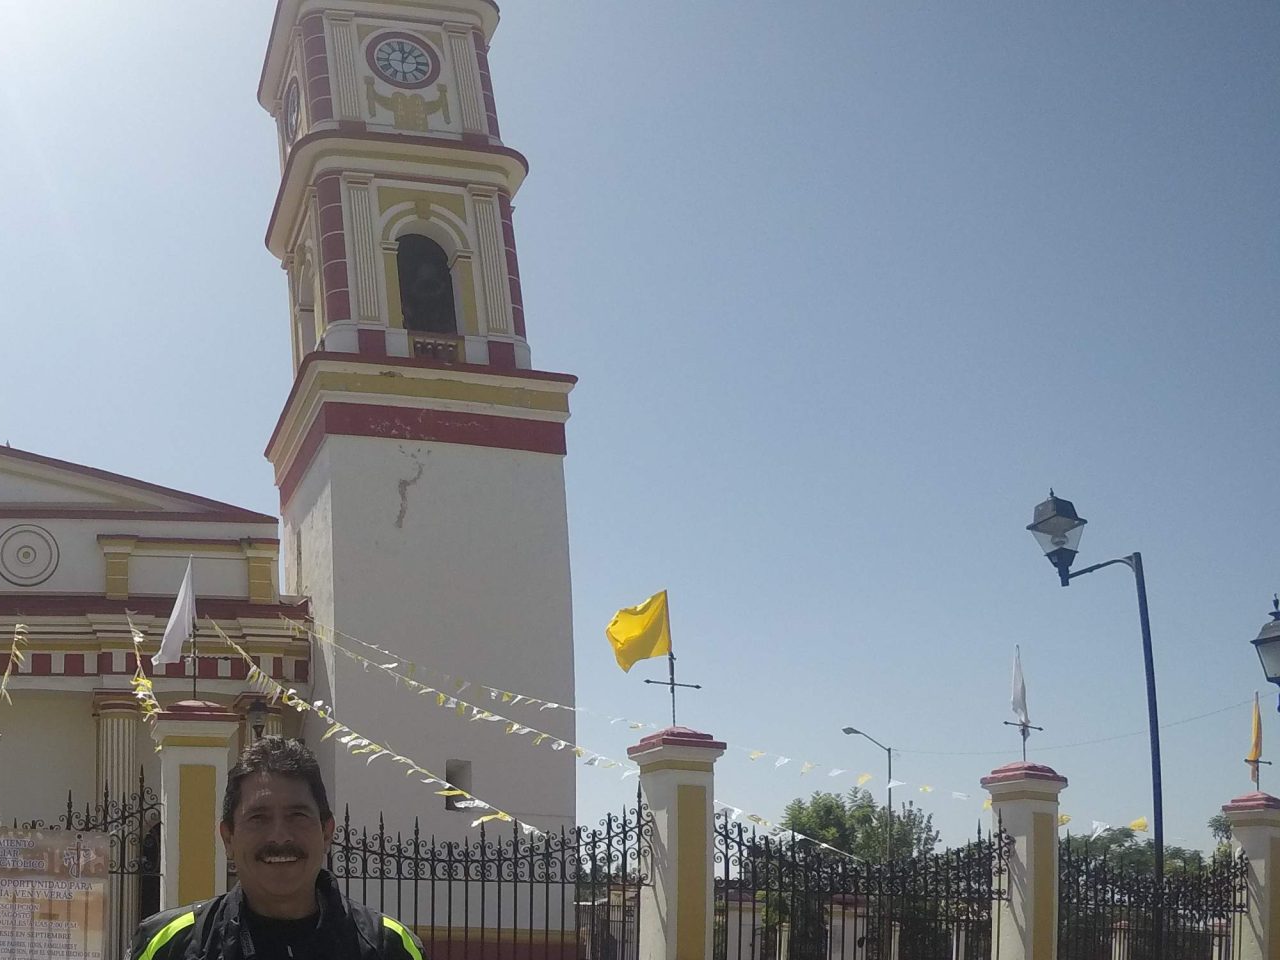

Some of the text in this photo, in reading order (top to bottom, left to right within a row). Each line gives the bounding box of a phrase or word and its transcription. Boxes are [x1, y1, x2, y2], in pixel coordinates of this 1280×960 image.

[0, 879, 67, 889] OPORTUNIDAD
[69, 881, 93, 890] PARA
[15, 889, 33, 898] VEN
[27, 931, 72, 939] SEPTIEMBRE
